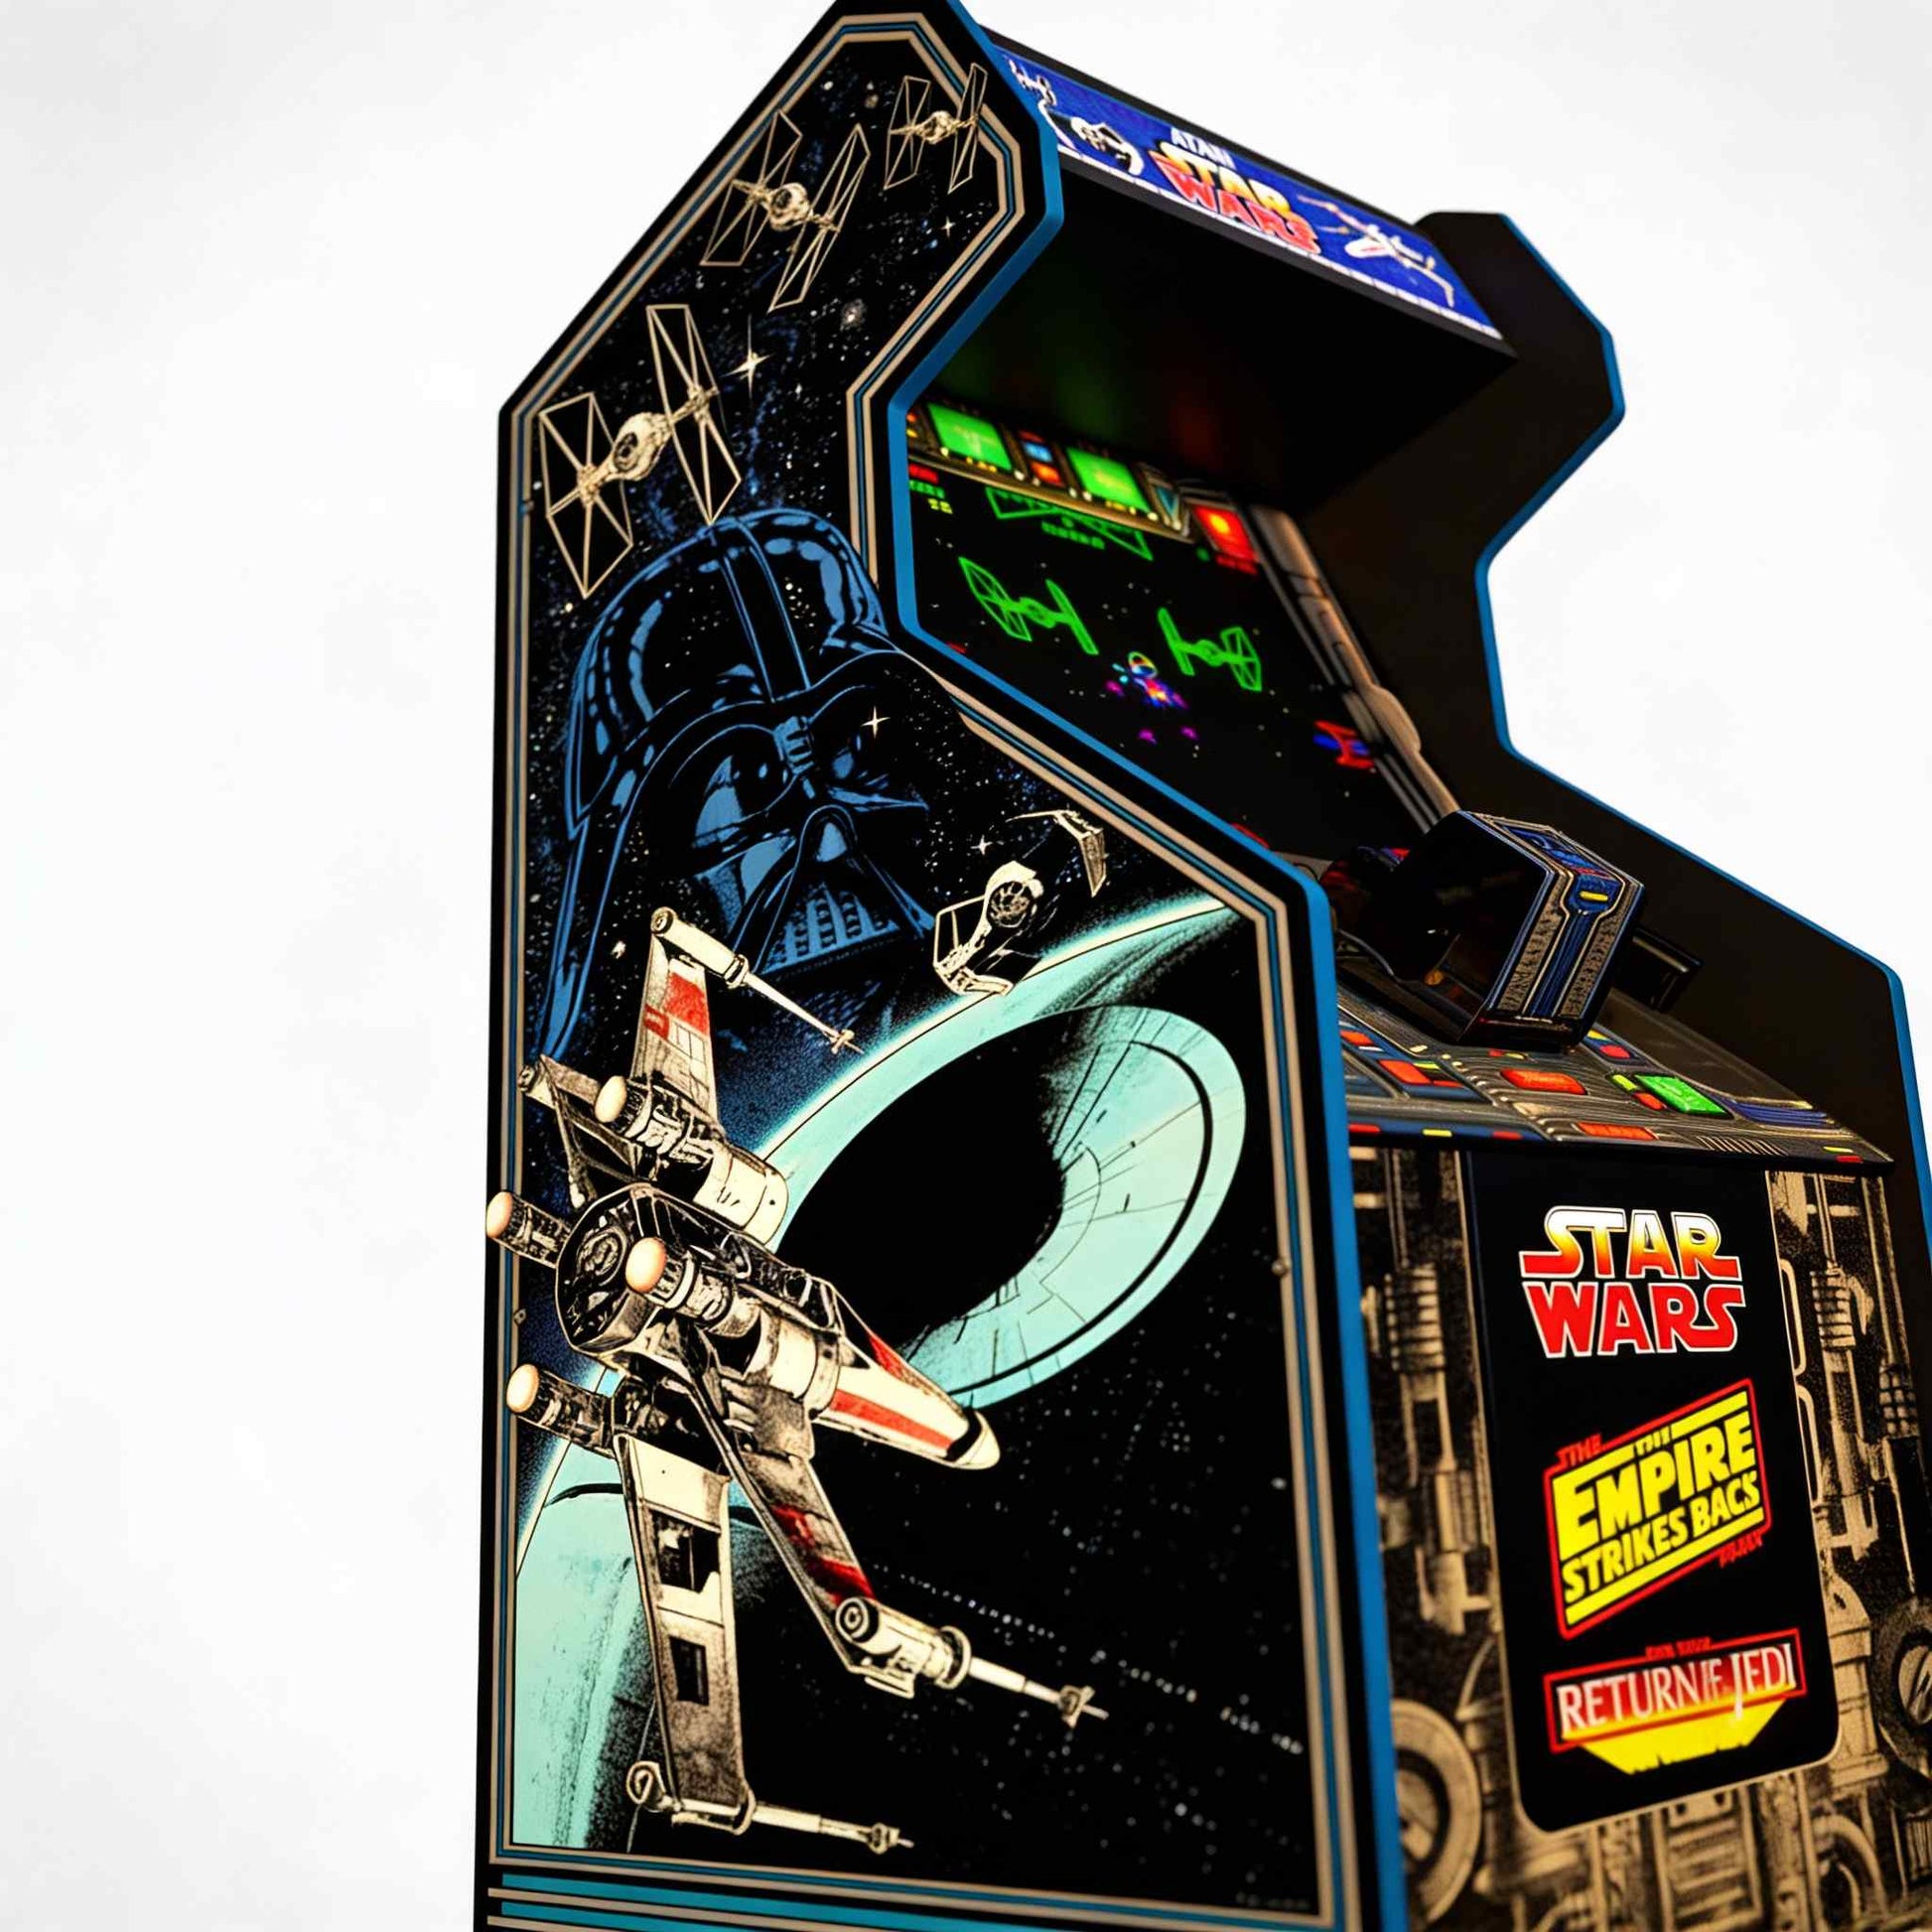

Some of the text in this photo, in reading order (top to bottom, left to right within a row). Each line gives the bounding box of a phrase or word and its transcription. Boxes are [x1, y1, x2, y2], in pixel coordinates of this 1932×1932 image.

[1152, 157, 1321, 254] WARS
[1518, 1205, 1742, 1281] STAR
[1522, 1281, 1746, 1358] WARS
[1552, 1410, 1756, 1562] EMPIRE
[1562, 1507, 1688, 1604] STRIKES
